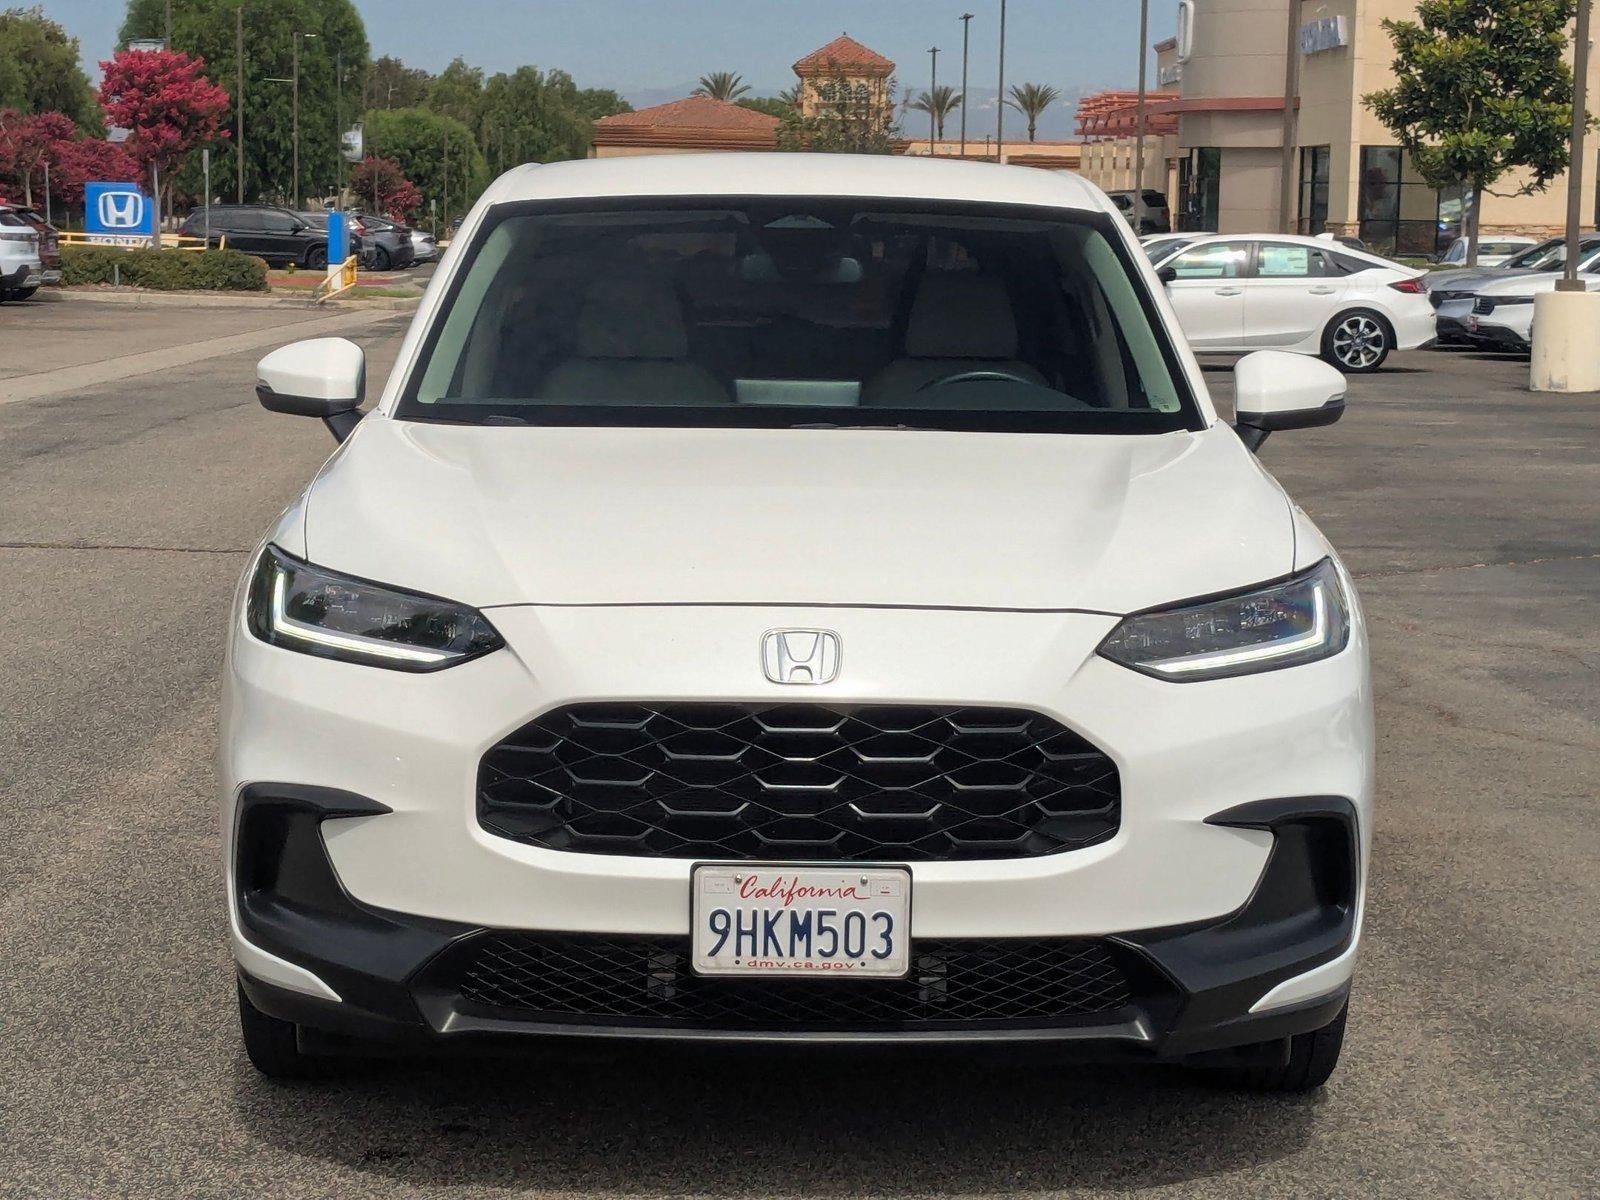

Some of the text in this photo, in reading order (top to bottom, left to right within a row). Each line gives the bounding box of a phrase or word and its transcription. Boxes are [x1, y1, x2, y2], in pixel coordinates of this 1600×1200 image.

[739, 875, 870, 907] California
[707, 908, 894, 960] 9HKM503
[747, 960, 855, 970] dmv.ca.gov
